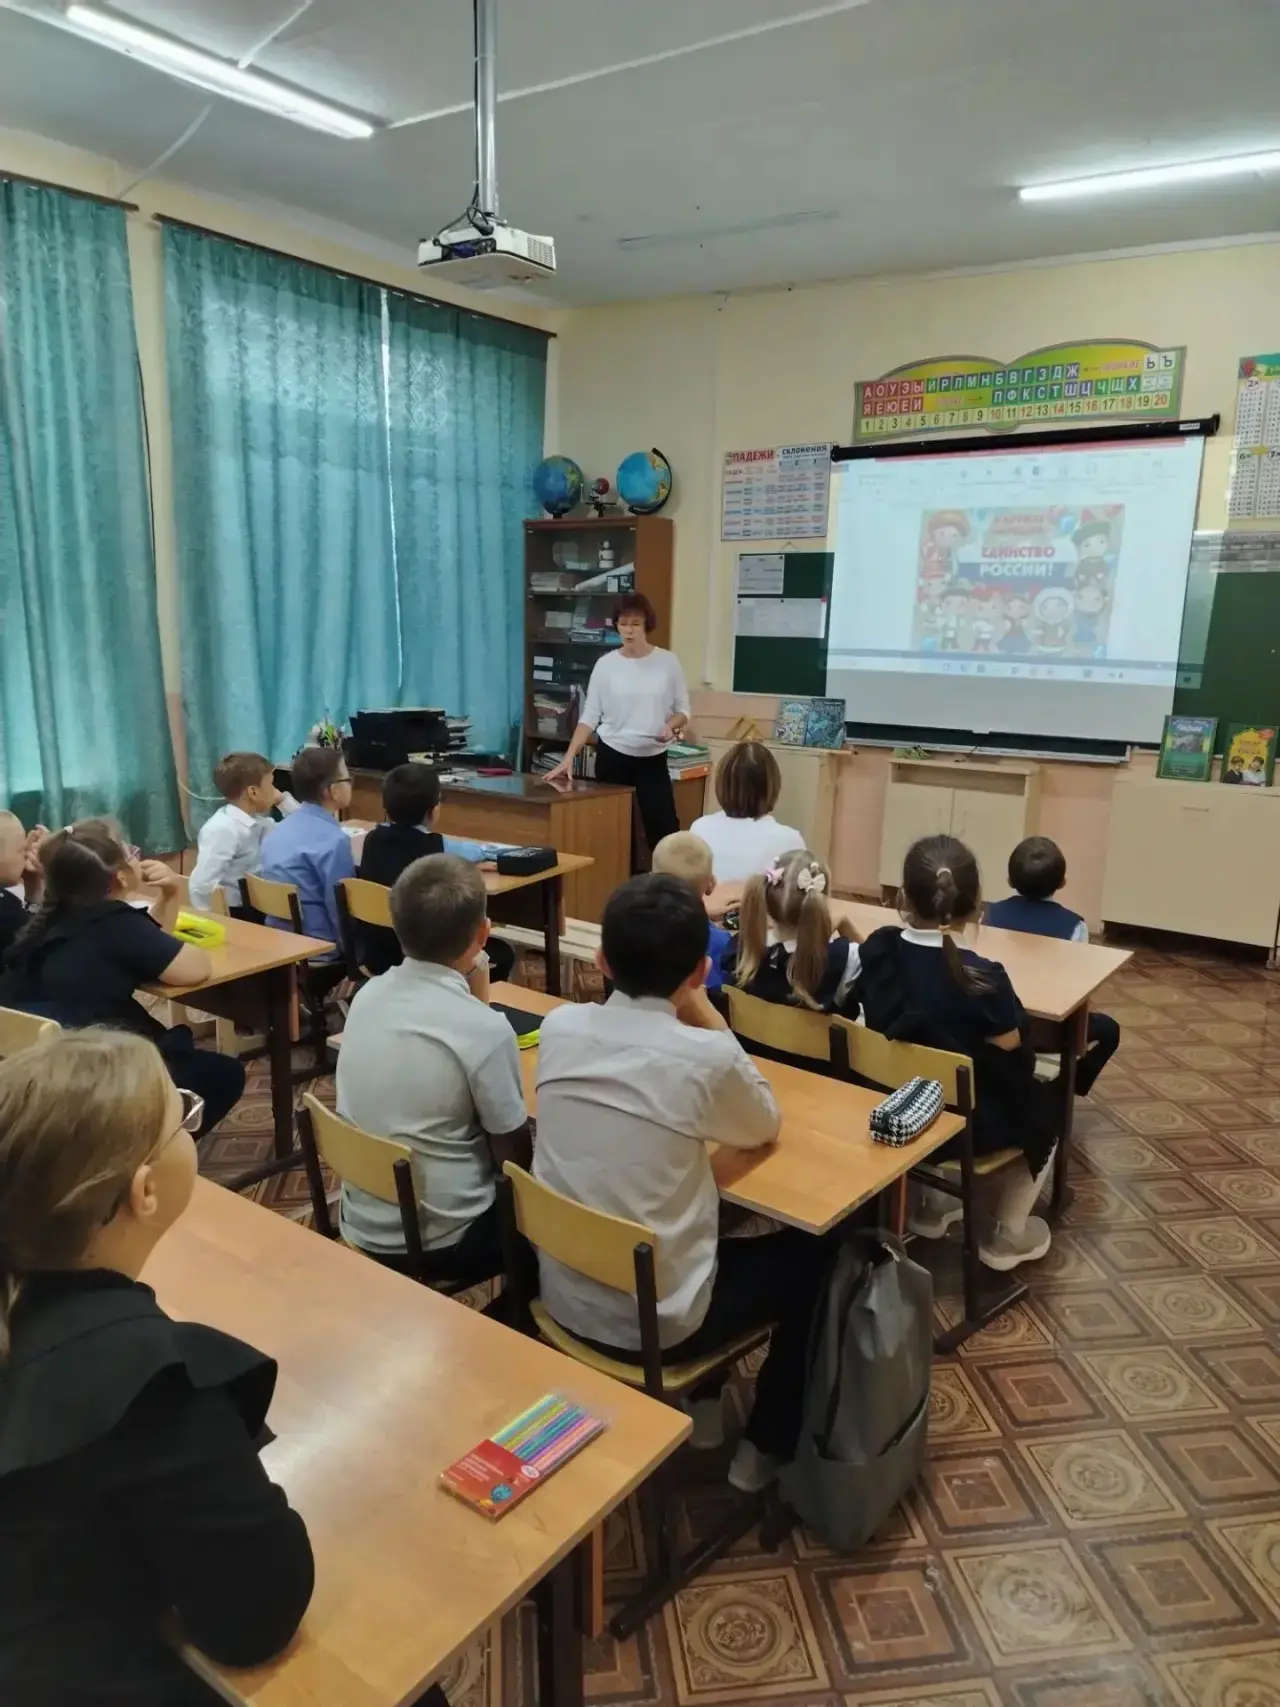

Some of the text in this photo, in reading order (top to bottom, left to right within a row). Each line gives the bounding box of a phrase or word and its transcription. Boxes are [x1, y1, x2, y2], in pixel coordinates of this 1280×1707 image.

[876, 385, 885, 396] О
[889, 384, 897, 396] У
[902, 382, 910, 394] Э
[913, 381, 924, 393] Ы
[941, 379, 949, 391] Р
[967, 376, 976, 388] М
[981, 374, 990, 386] Н
[996, 372, 1003, 385] Б
[1009, 371, 1018, 384] В
[1024, 370, 1032, 382] Г
[1066, 364, 1078, 378] Ж
[864, 404, 871, 415] Я
[887, 401, 897, 413] Ю
[994, 391, 1002, 404] П
[1007, 389, 1017, 400] Ф
[1023, 388, 1031, 400] К
[1037, 386, 1046, 399] С
[1051, 385, 1060, 397] Т
[1129, 377, 1137, 390] Х
[991, 409, 1000, 418] 10
[1007, 408, 1016, 418] 11
[1021, 406, 1032, 417] 12
[1037, 404, 1048, 416] 13
[1053, 403, 1064, 413] 14
[1069, 401, 1081, 413] 15
[1086, 400, 1098, 411] 16
[1103, 398, 1115, 410] 17
[1120, 396, 1132, 408] 18
[1137, 395, 1149, 407] 19
[1154, 393, 1167, 405] 20
[733, 449, 774, 463] ПАДЕЖИ
[982, 546, 1055, 559] ЕДИНСТВО
[980, 563, 1054, 577] РОССИИ!
